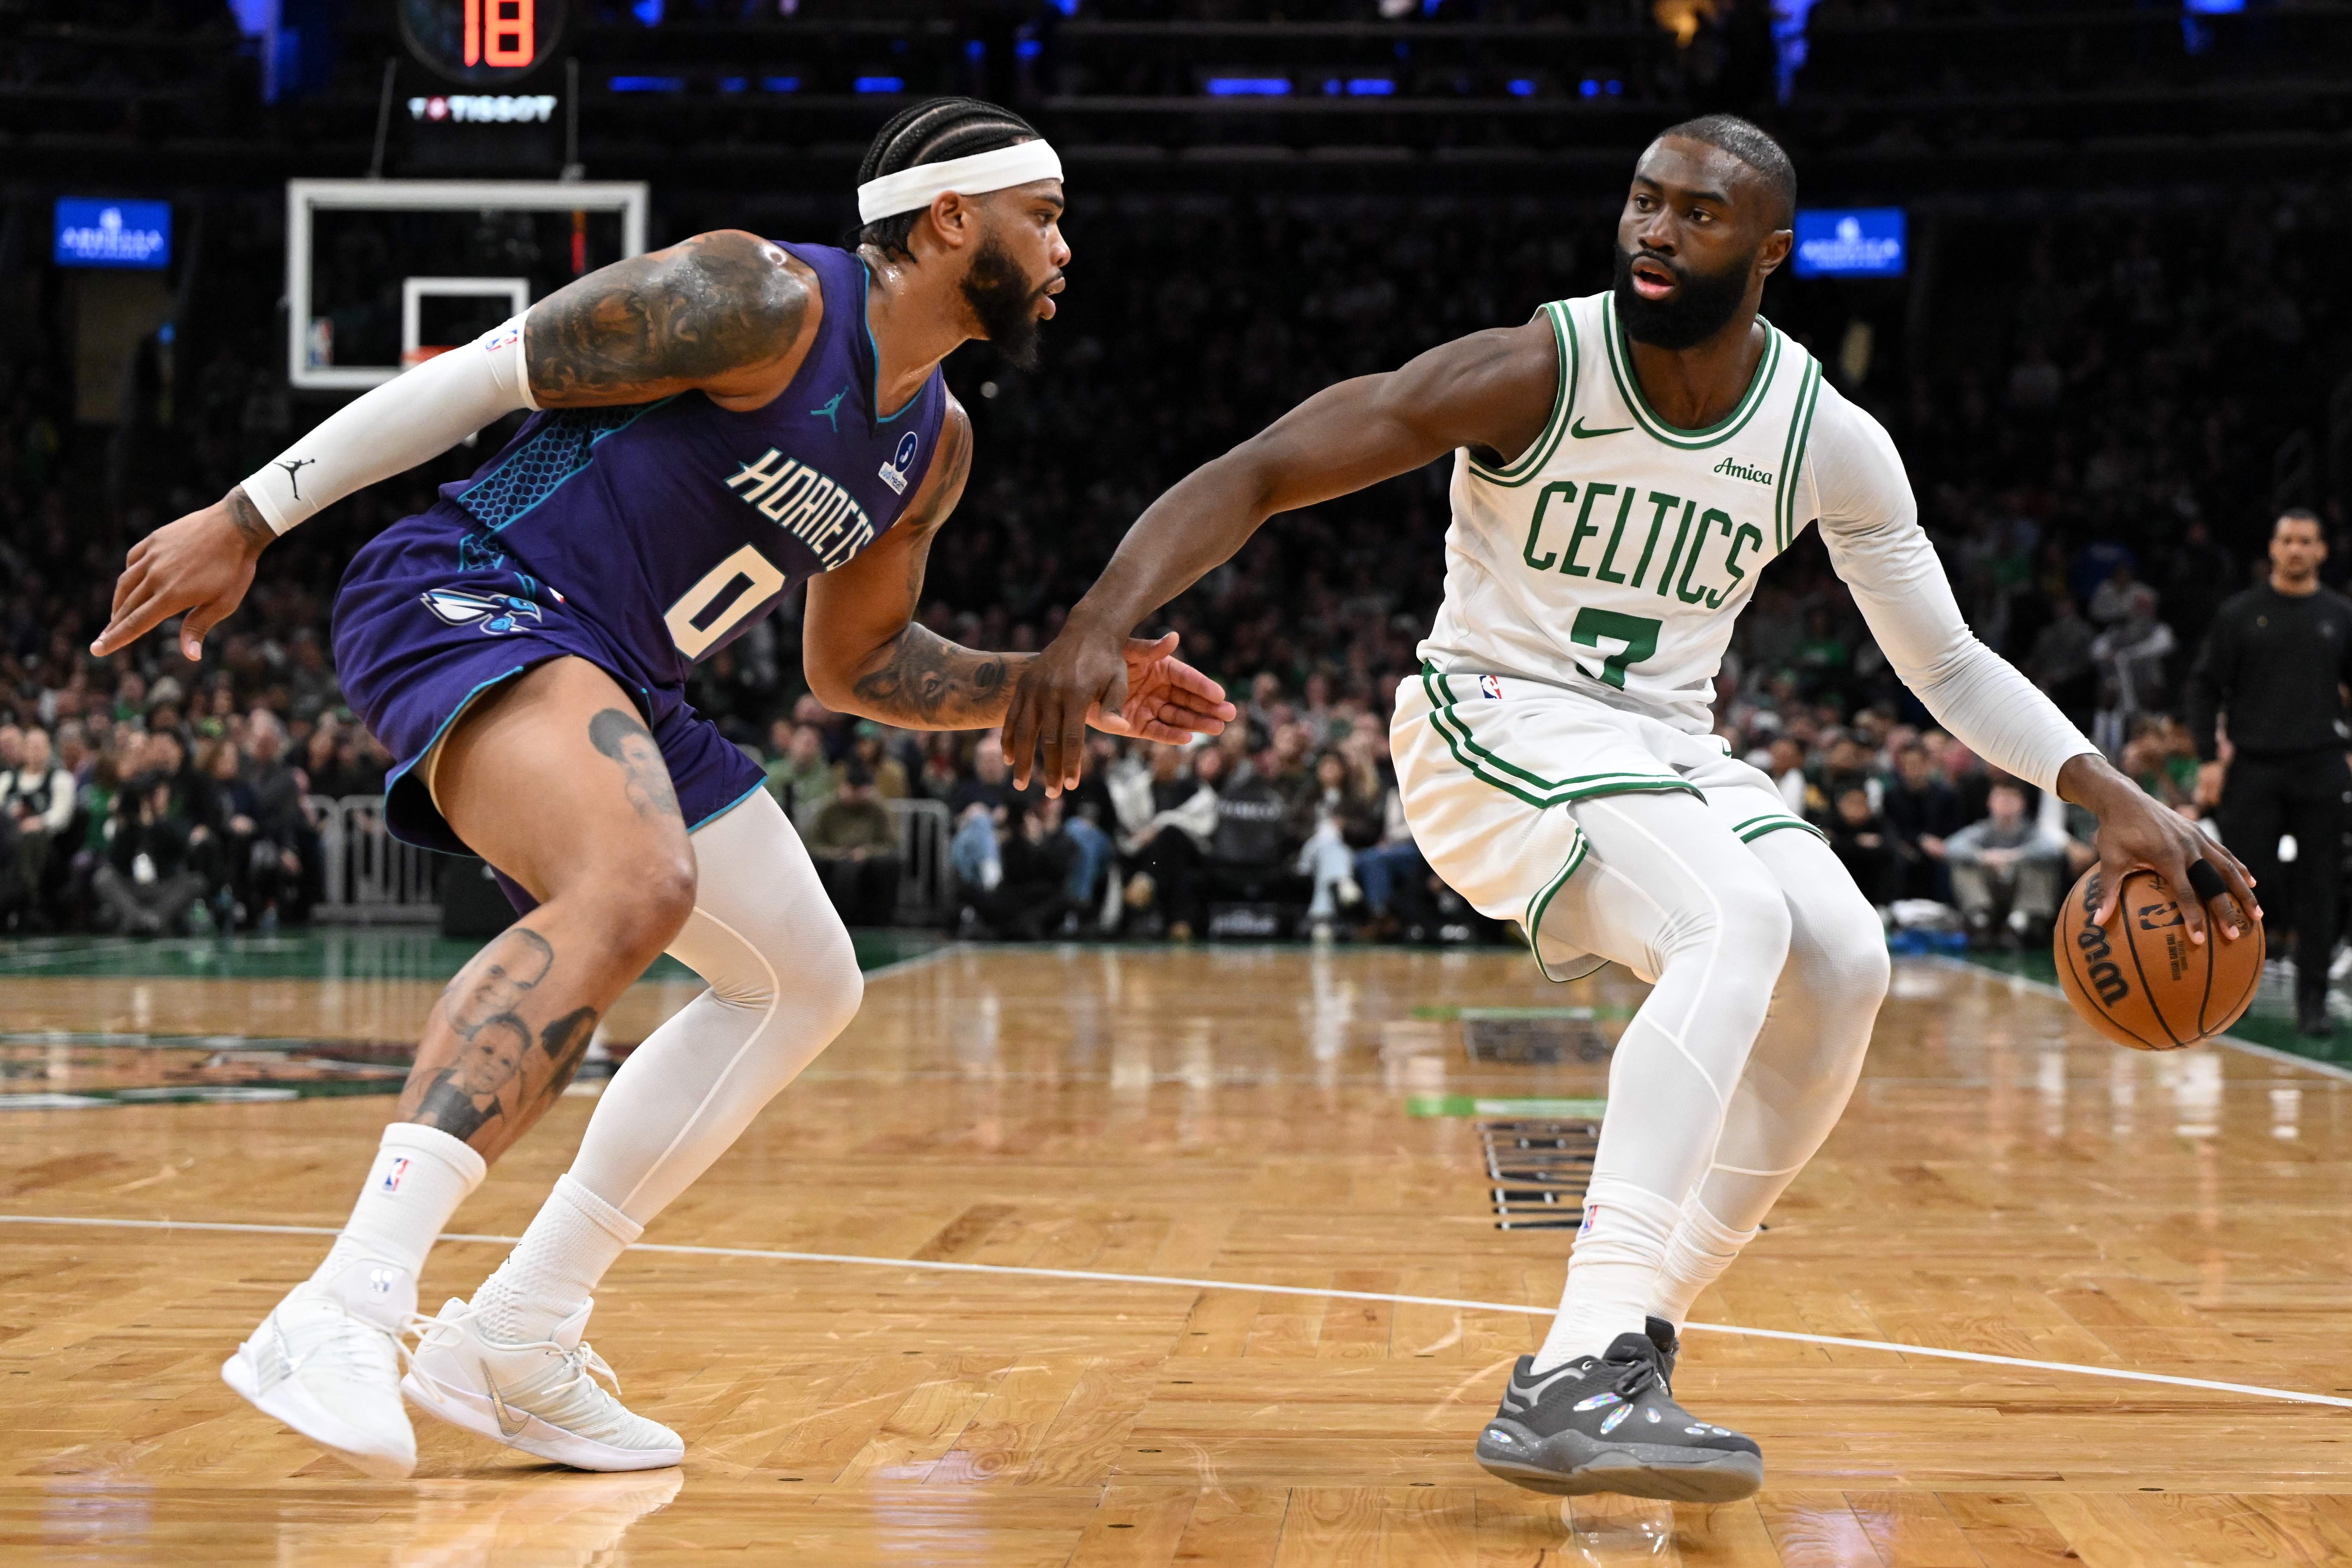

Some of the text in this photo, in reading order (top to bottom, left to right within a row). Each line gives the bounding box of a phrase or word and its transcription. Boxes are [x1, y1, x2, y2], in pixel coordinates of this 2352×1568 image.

[464, 0, 534, 67] 18
[723, 446, 875, 573] HORNETS
[1713, 457, 1772, 485] Amica
[1523, 480, 1763, 609] CELTICS
[663, 542, 787, 660] 0
[1570, 607, 1663, 691] 7
